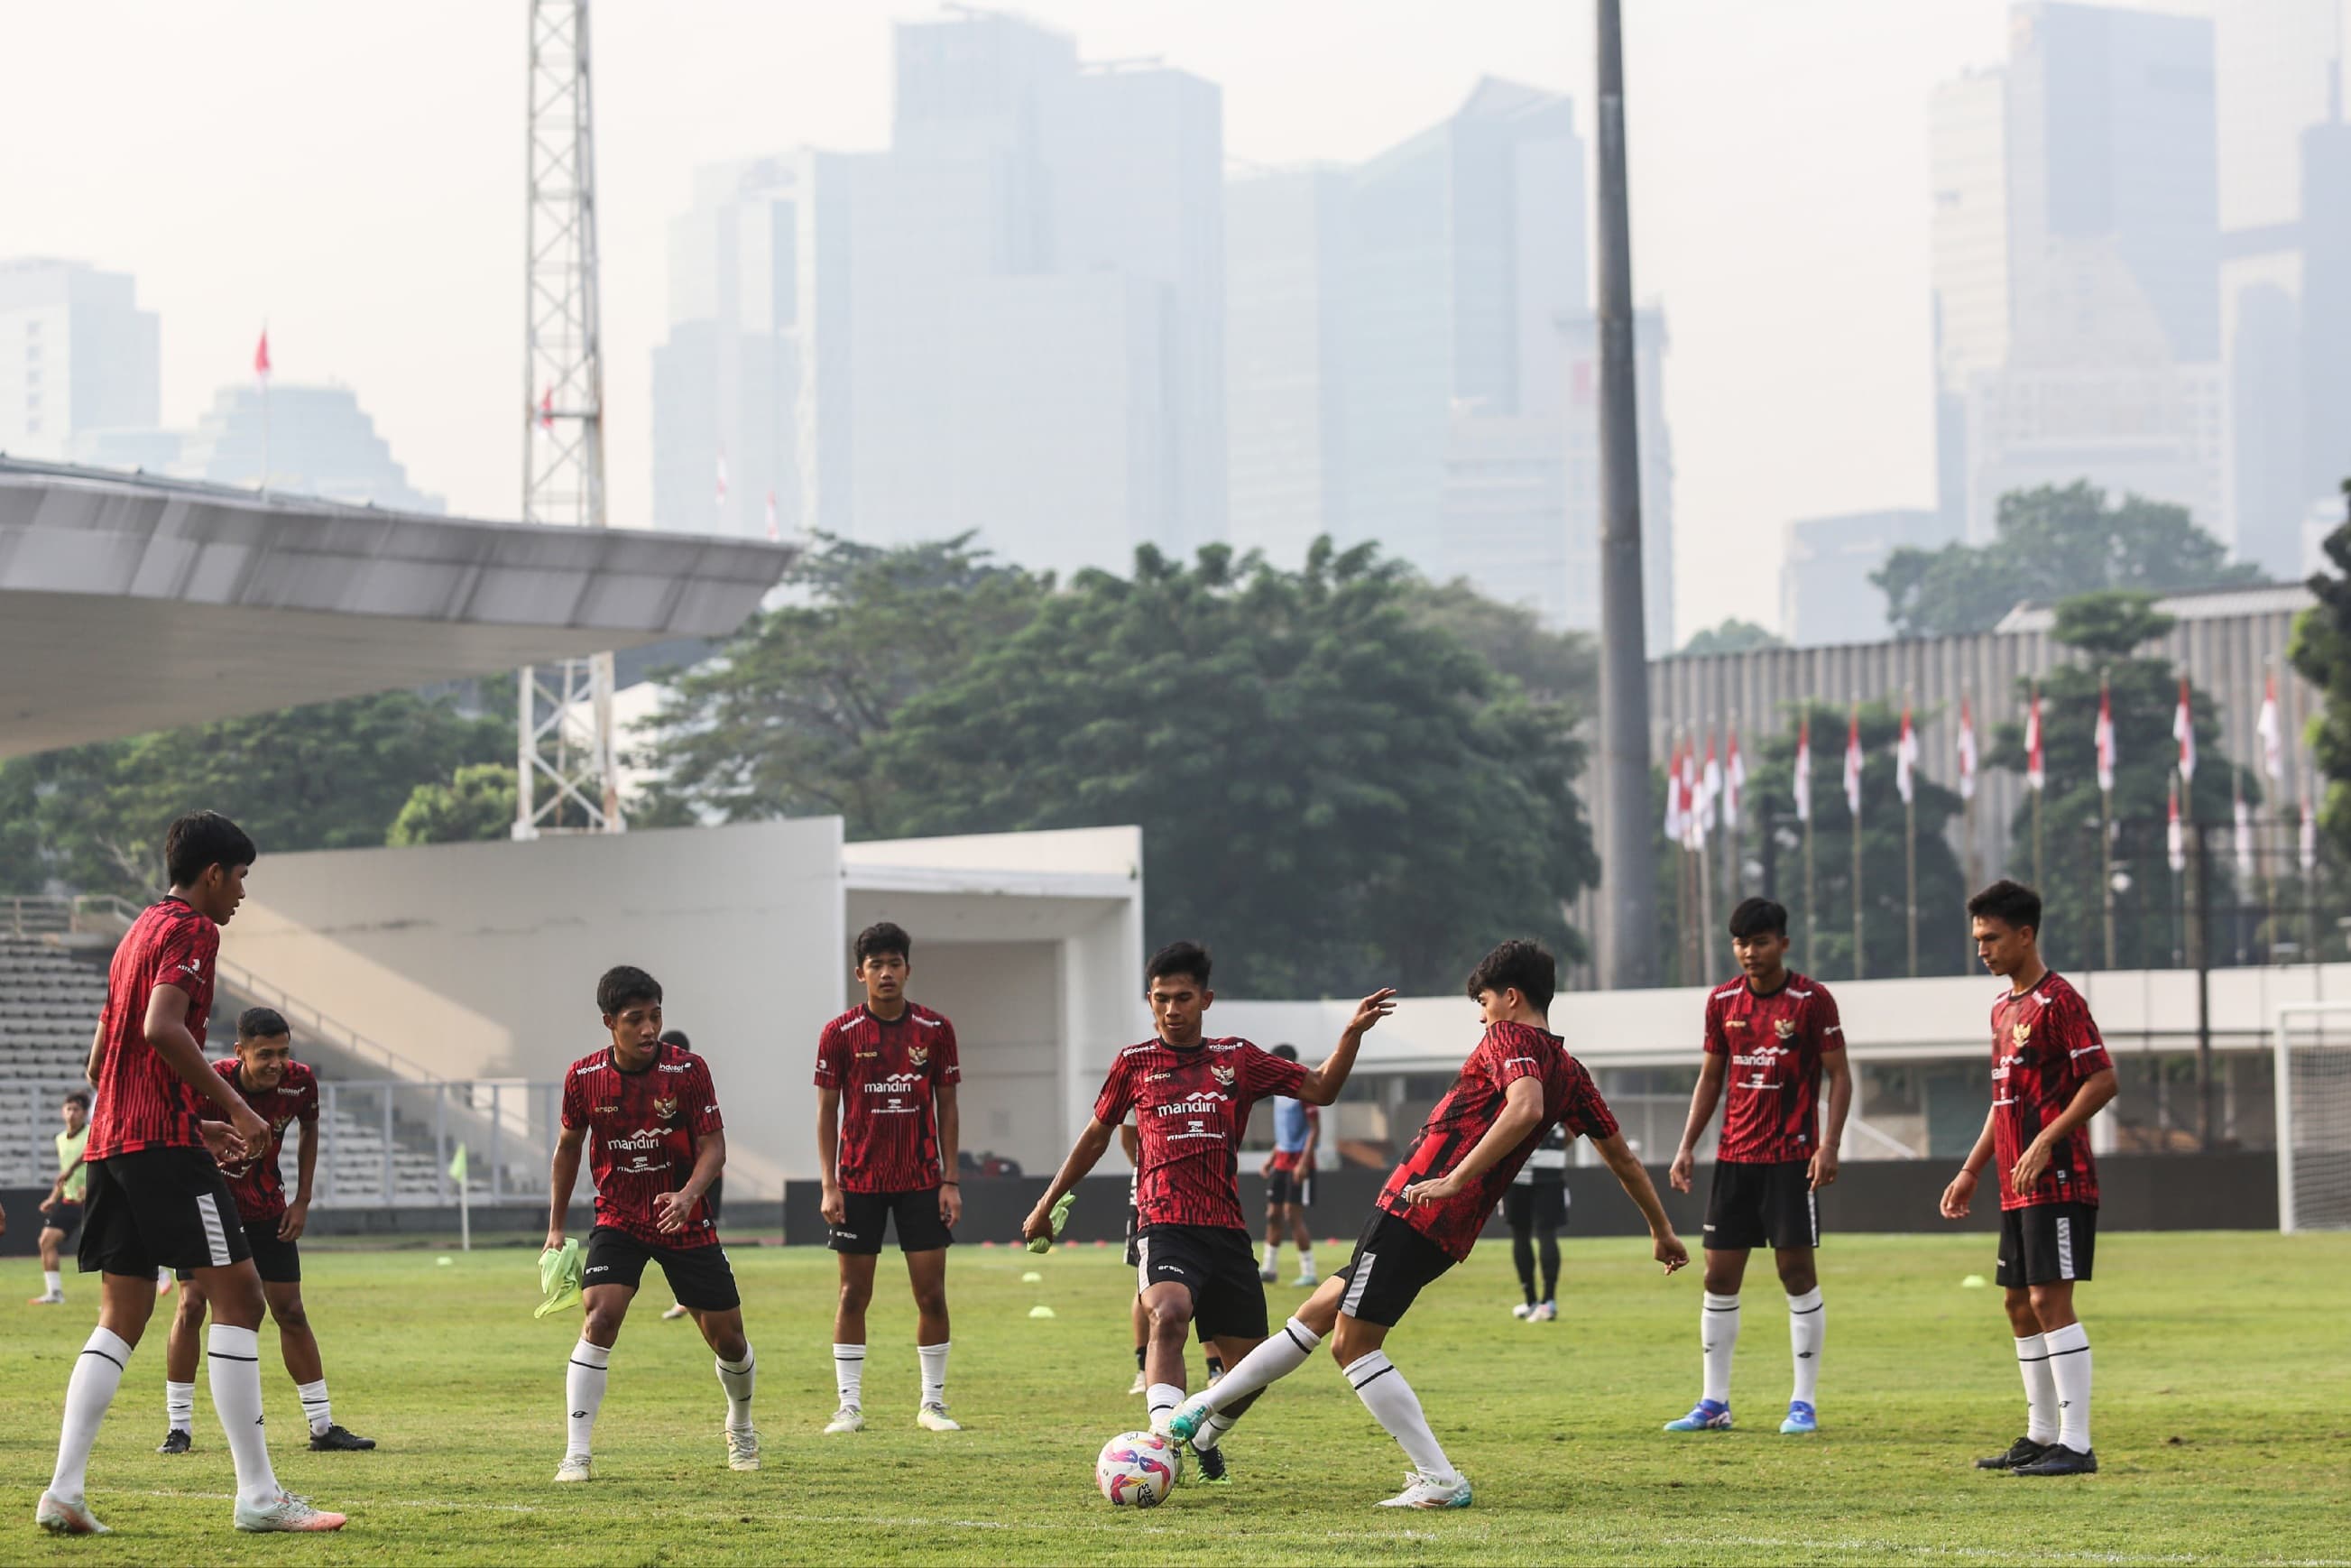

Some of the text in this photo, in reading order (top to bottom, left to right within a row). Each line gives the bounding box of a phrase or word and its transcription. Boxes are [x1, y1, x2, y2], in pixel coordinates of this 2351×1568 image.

[1732, 1054, 1775, 1066] mandiri
[1144, 1072, 1171, 1083] erspo
[864, 1080, 911, 1093] mandiri
[1157, 1099, 1216, 1118] mandiri
[607, 1136, 659, 1150] mandiri
[585, 1265, 609, 1275] erspo
